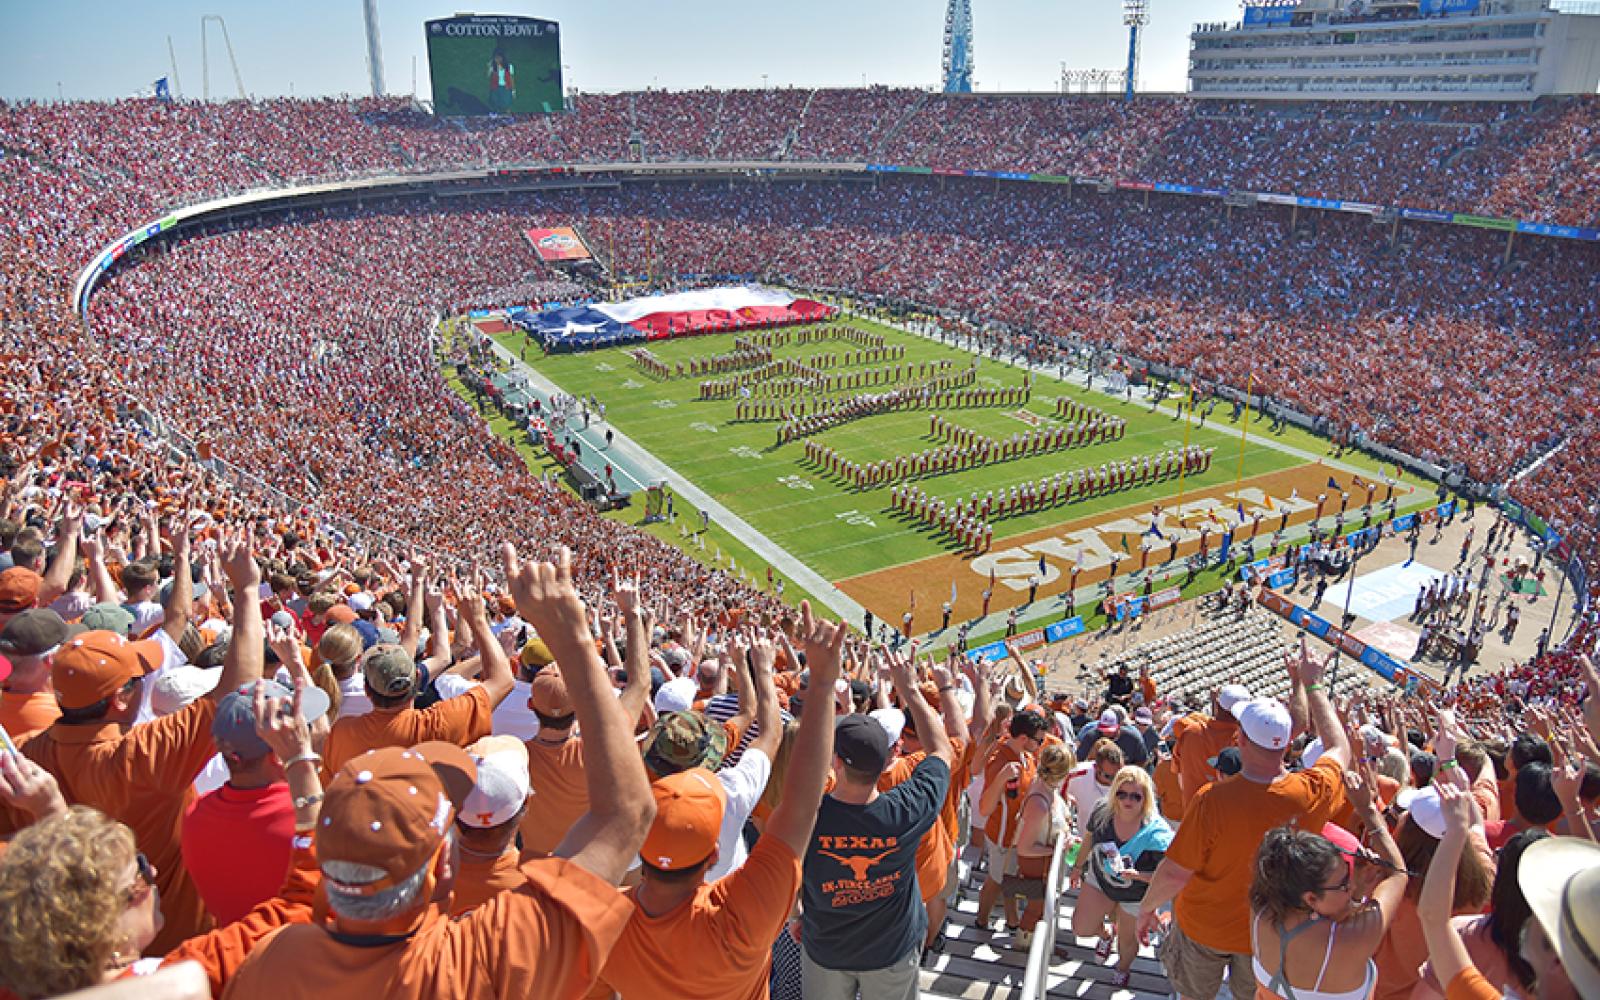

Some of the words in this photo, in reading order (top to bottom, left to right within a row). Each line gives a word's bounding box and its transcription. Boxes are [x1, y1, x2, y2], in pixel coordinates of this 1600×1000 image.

[446, 23, 501, 36] COTTON
[503, 23, 543, 36] BOWL
[969, 486, 1318, 592] TEXAS
[477, 812, 493, 825] T
[818, 836, 897, 849] TEXAS
